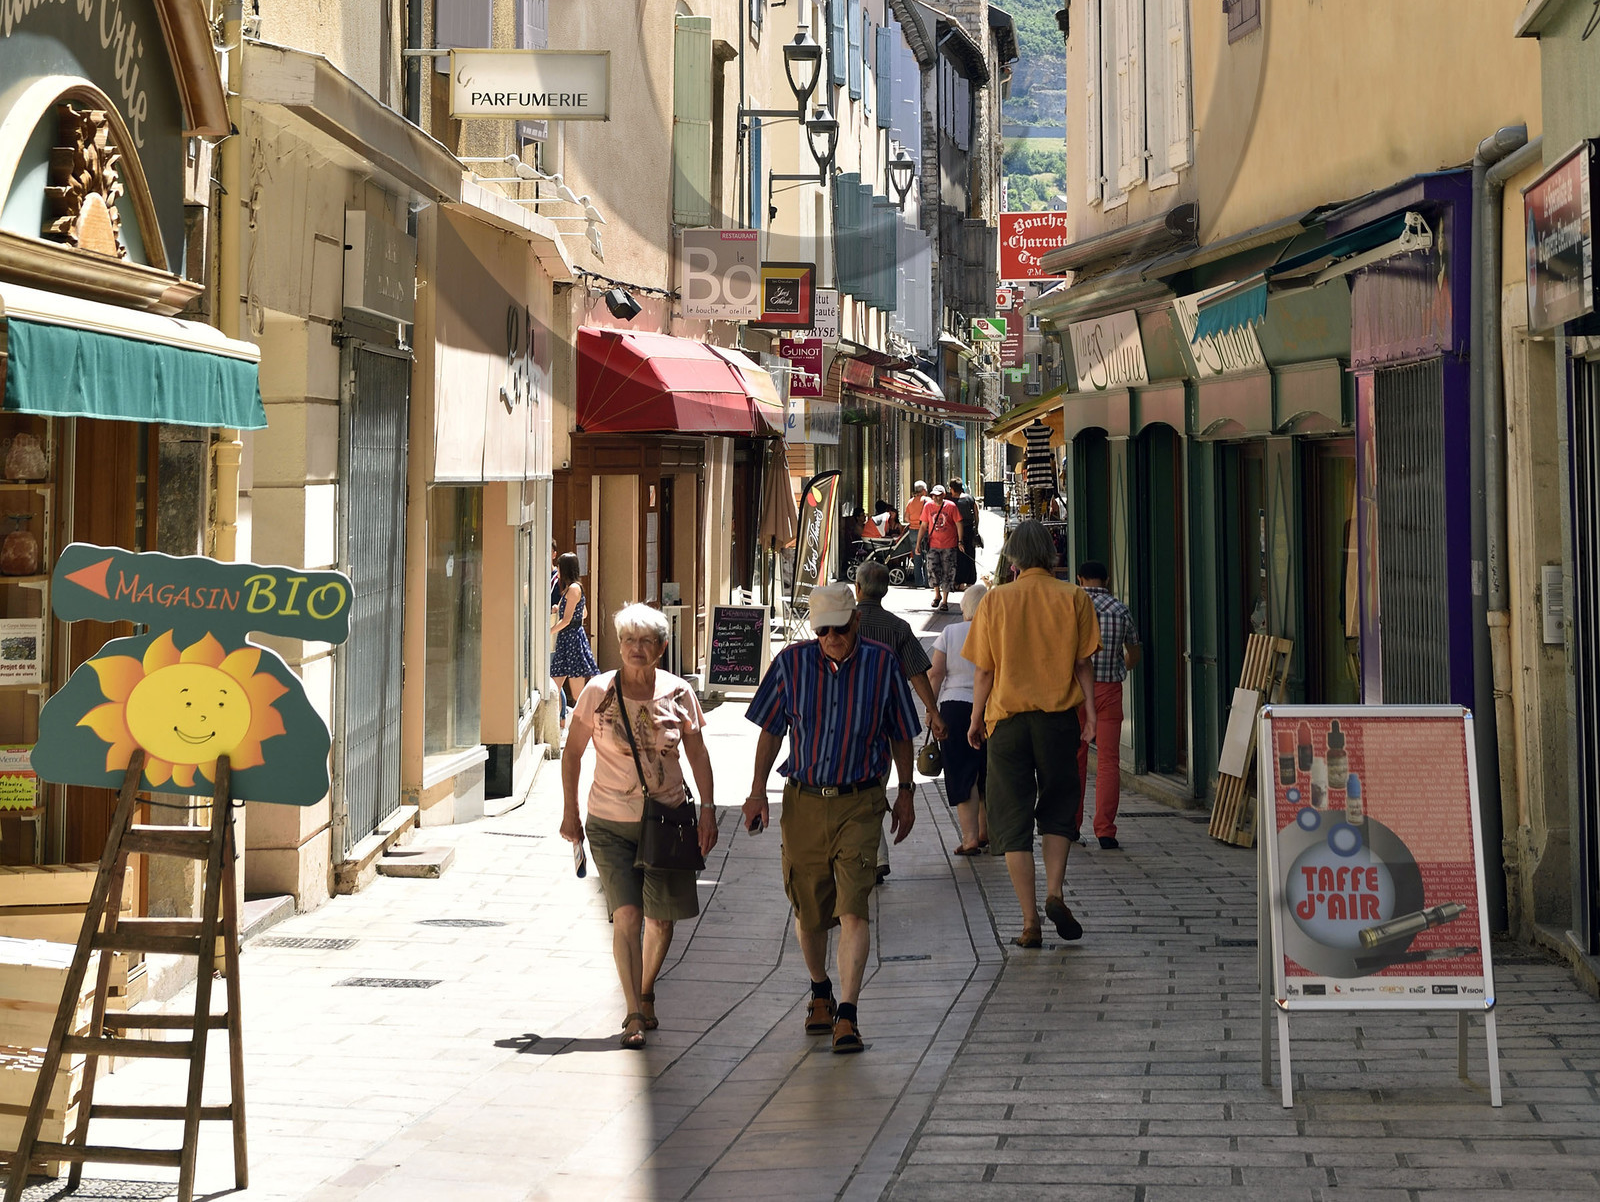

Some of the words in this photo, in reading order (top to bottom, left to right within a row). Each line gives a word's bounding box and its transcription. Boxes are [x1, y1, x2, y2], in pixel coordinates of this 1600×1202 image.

[470, 91, 589, 108] PARFUMERIE
[721, 232, 757, 240] RESTAURANT
[736, 251, 745, 263] le
[684, 247, 758, 305] Bo
[815, 293, 830, 305] itut
[686, 304, 693, 314] le
[695, 304, 719, 314] bouche
[729, 304, 752, 315] oreille
[815, 306, 836, 317] eauté
[781, 345, 821, 357] GUINOT
[1075, 323, 1096, 381] Chez
[1089, 321, 1146, 391] Sabine
[793, 380, 818, 388] BEAUT
[114, 570, 240, 611] MAGASIN
[244, 574, 347, 620] BIO
[1301, 866, 1379, 892] TAFFE
